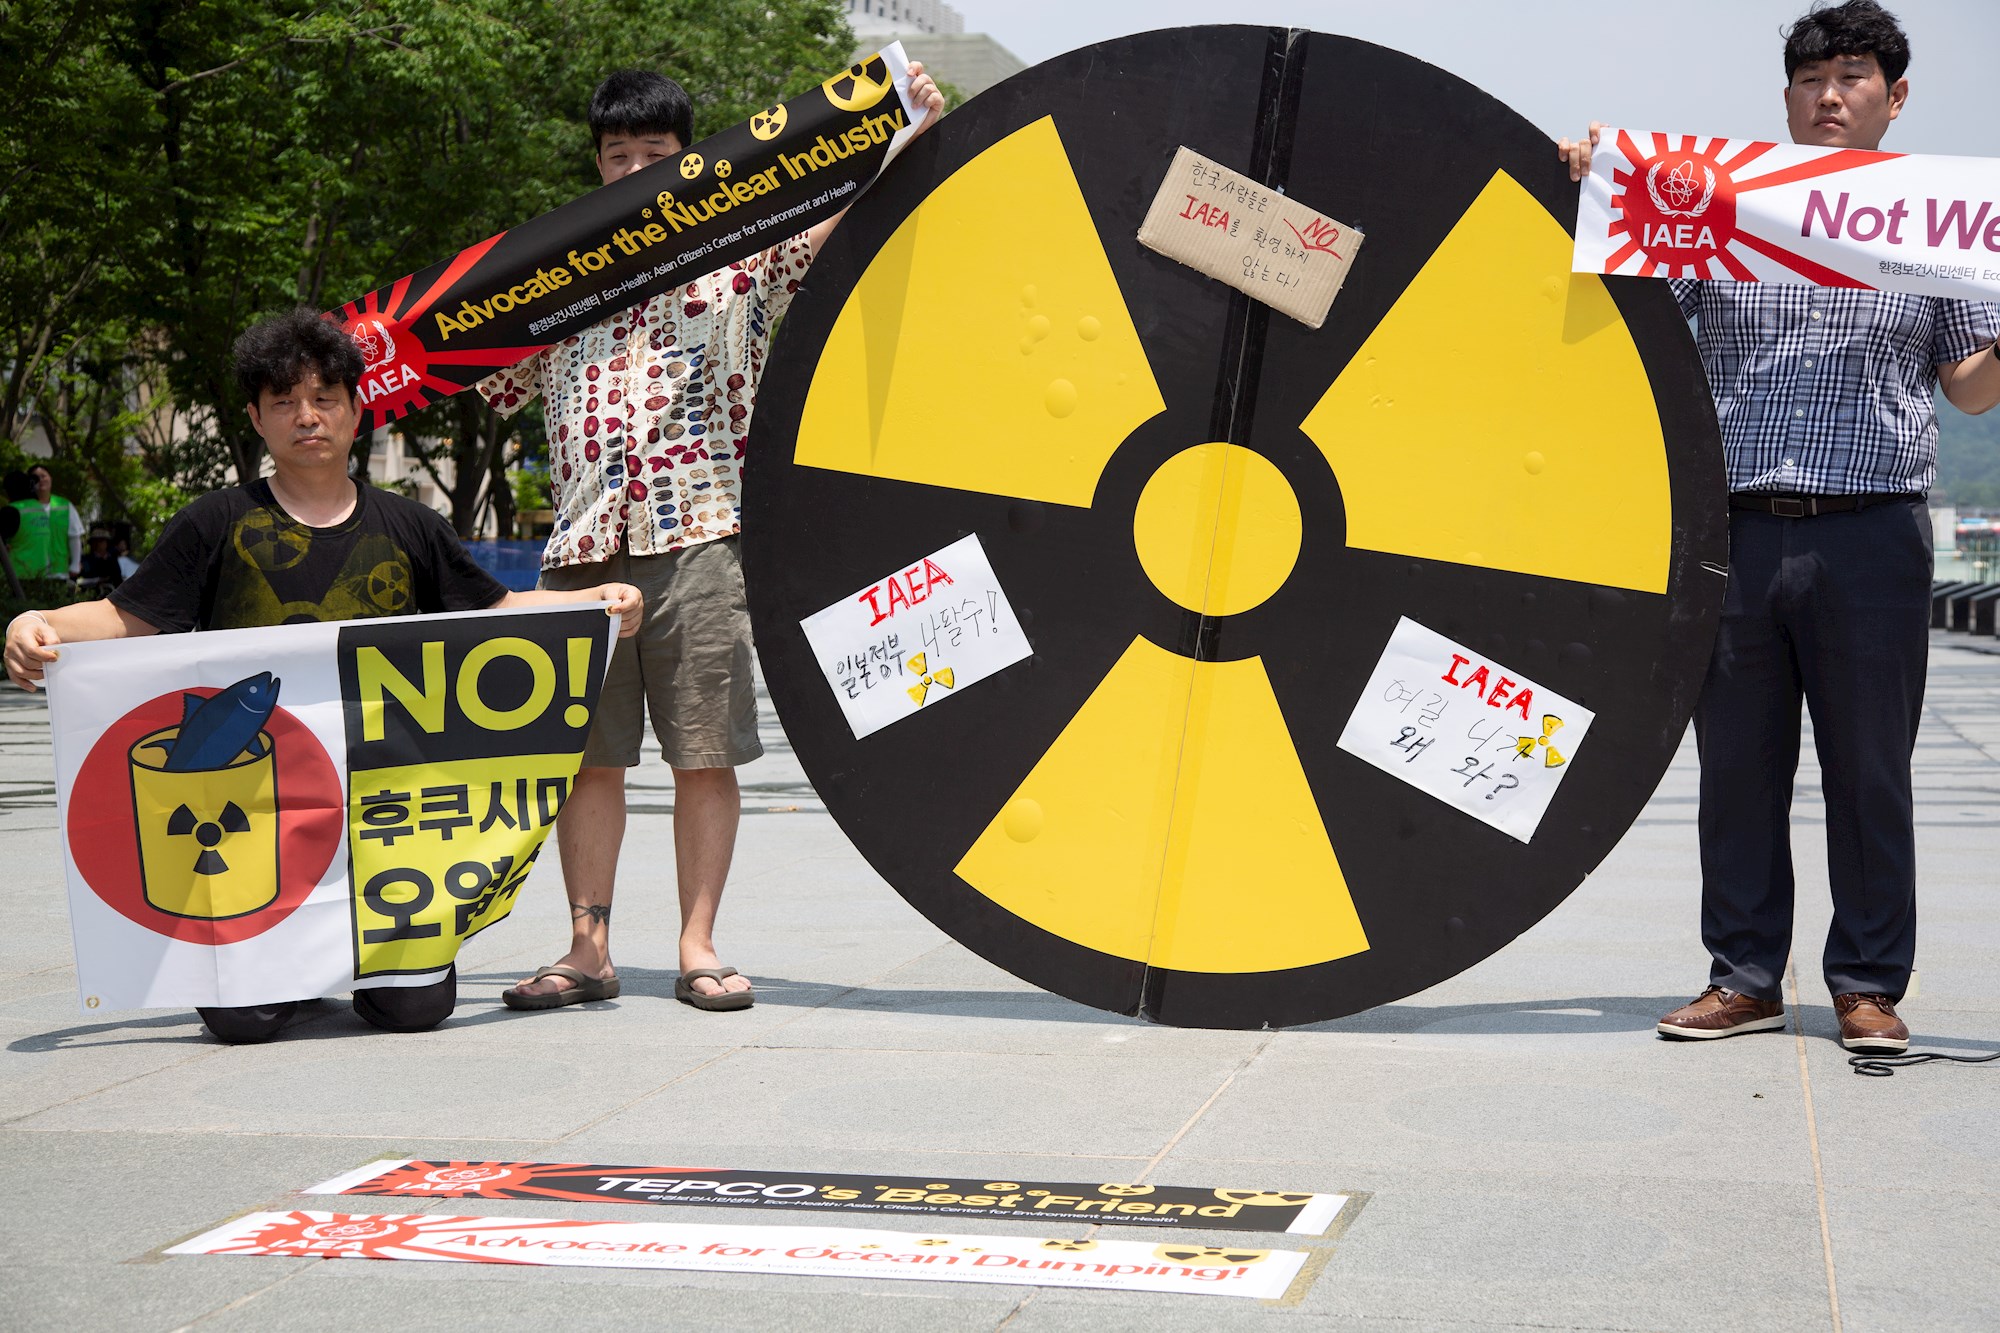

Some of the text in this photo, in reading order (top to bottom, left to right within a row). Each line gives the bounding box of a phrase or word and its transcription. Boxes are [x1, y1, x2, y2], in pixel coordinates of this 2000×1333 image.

[434, 108, 905, 341] Advocate for the Nuclear Industry
[1302, 217, 1340, 247] NO
[1643, 223, 1717, 250] IAEA
[1801, 190, 1909, 245] Not
[528, 180, 857, 335] 환경보건시민센터 Eco-Health: Asian Citizen's Center for Environment and Health
[1879, 260, 1976, 280] 환경보건시민센터
[357, 363, 421, 405] IAEA
[858, 558, 954, 627] IAEA
[356, 637, 593, 742] NO!
[836, 633, 906, 700] 일본정부
[1441, 653, 1533, 721] IAEA
[1384, 679, 1449, 728] 여길
[1389, 726, 1519, 801] 왜 와?
[395, 1182, 482, 1191] IAEA
[596, 1177, 1243, 1218] TEPCO's Best Friend
[884, 1204, 936, 1212] Citizen's
[1012, 1210, 1100, 1219] Environment
[268, 1239, 364, 1250] IAEA
[435, 1234, 1248, 1281] Advocate for Ocean Dumping!
